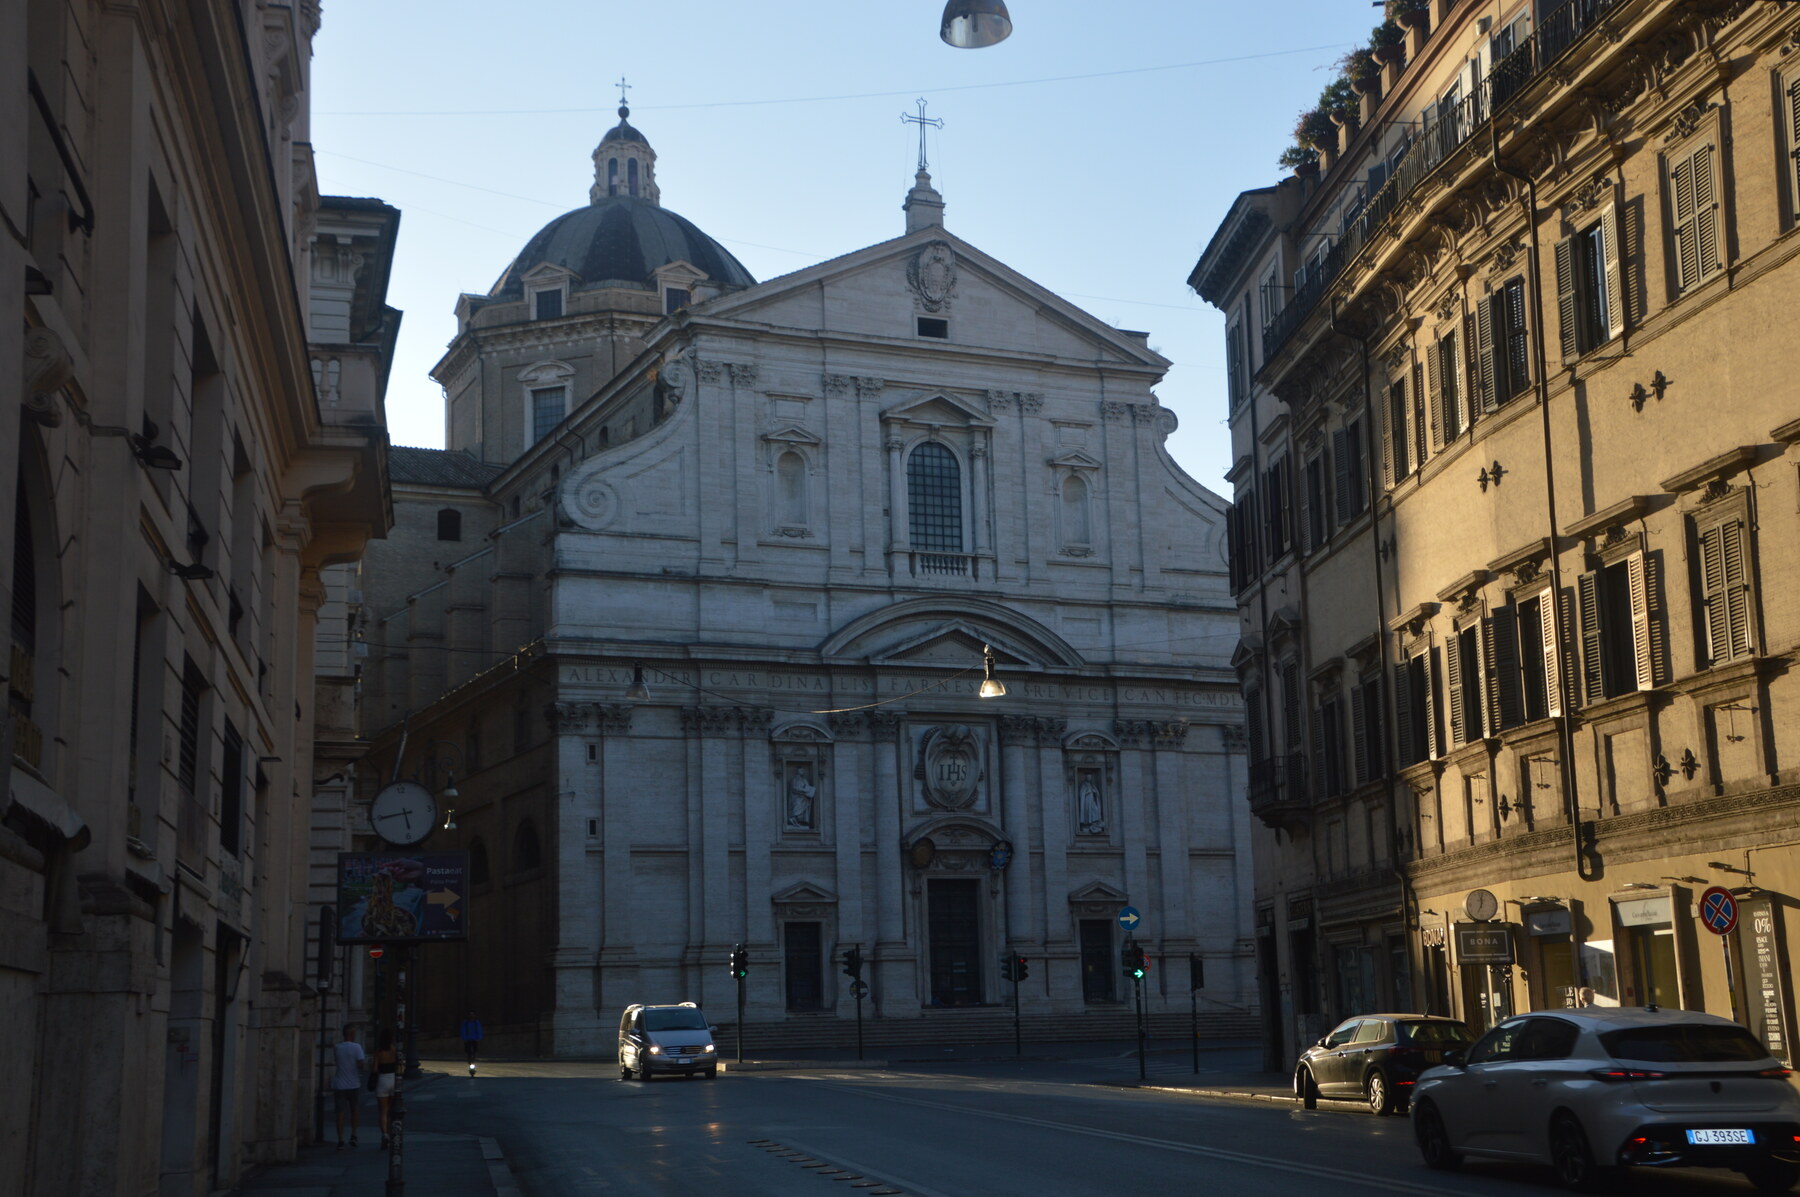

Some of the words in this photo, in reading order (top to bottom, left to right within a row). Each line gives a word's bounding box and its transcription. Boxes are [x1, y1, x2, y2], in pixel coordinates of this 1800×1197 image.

[569, 668, 692, 684] ALEXANDER
[890, 678, 1013, 695] FARNESS
[938, 764, 968, 782] IHS
[1695, 1131, 1709, 1142] GJ
[1712, 1131, 1747, 1142] 393SE
